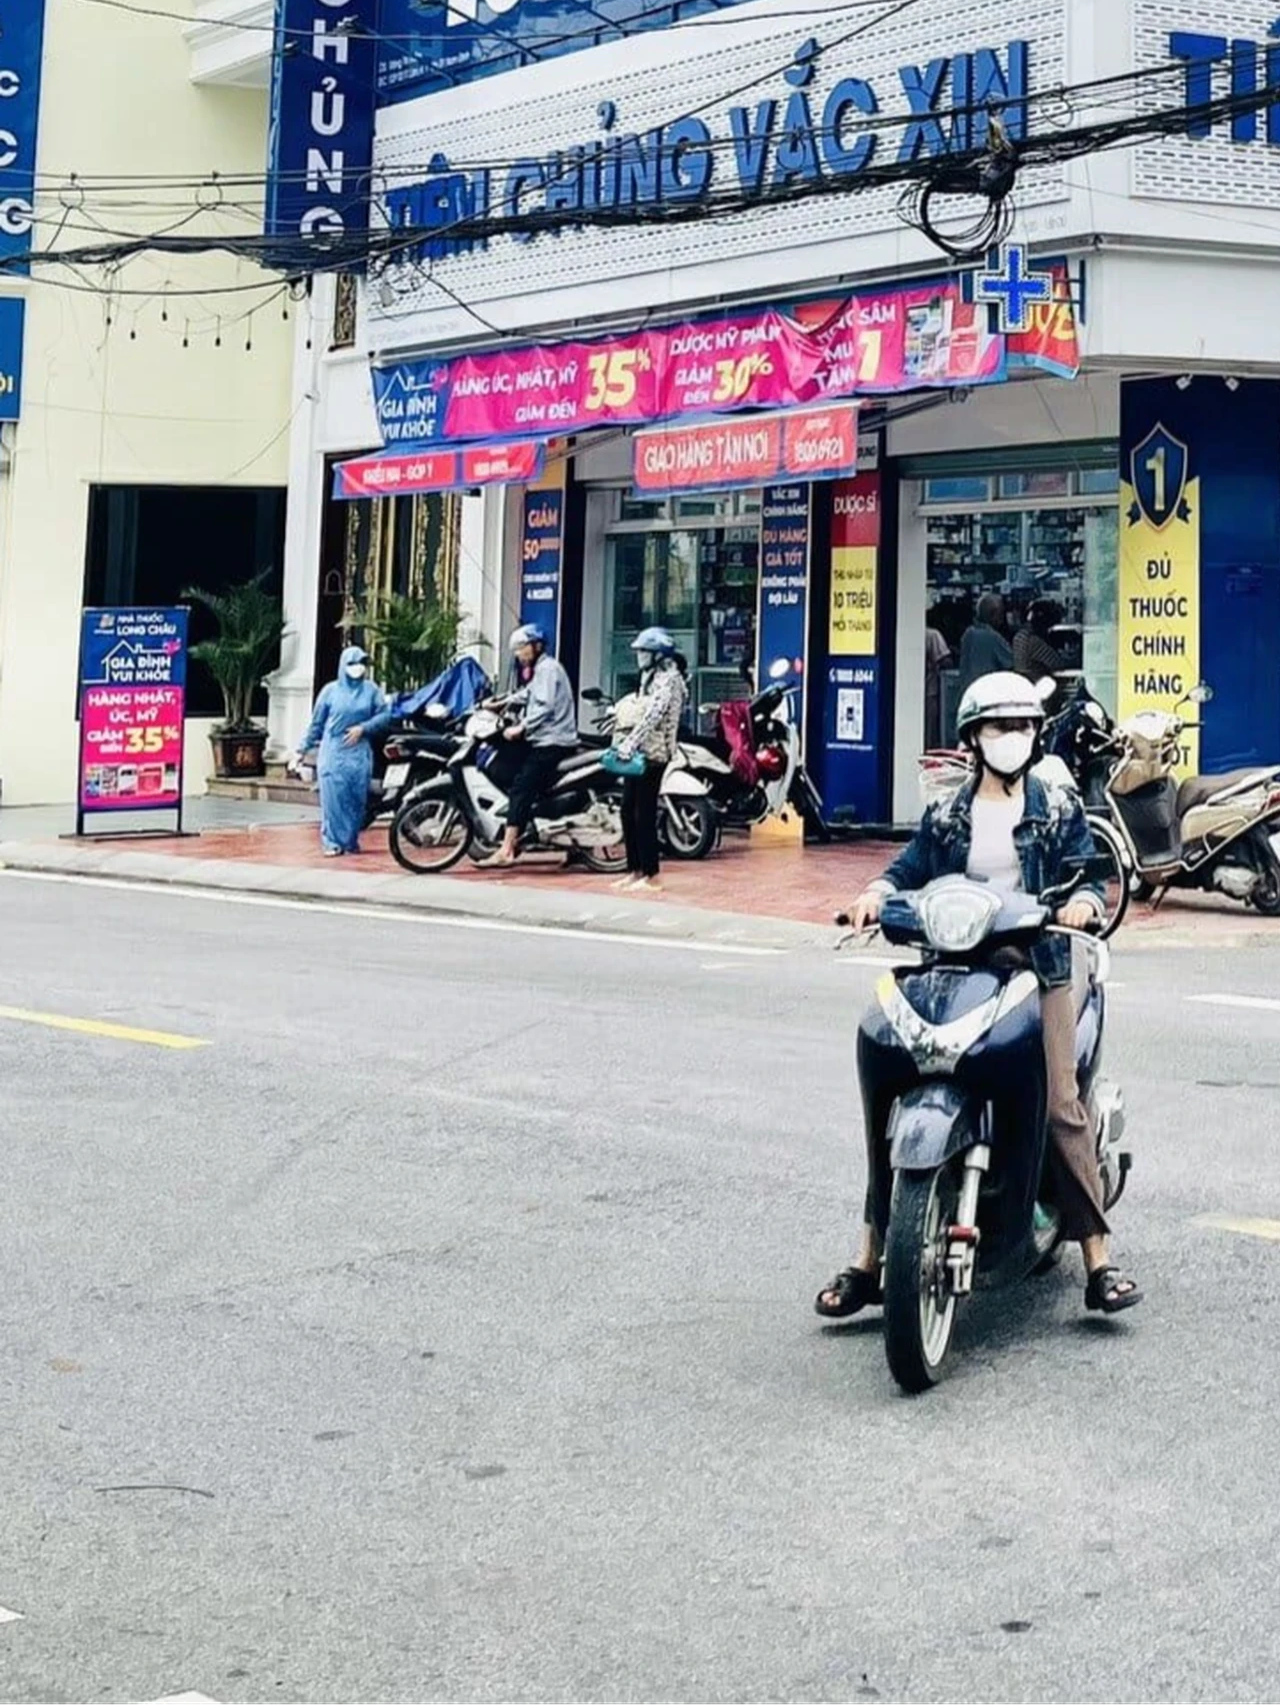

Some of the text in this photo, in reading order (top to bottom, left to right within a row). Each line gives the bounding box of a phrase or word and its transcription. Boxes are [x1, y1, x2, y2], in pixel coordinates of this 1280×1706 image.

[503, 101, 714, 243] CHỦNG
[730, 37, 880, 194] VẮC
[898, 40, 1028, 166] XIN
[858, 302, 896, 326] SÂM
[584, 347, 651, 411] 35%
[712, 352, 774, 402] 30%
[381, 398, 404, 420] GIA
[1145, 447, 1165, 511] 1
[1146, 551, 1172, 580] ĐỦ
[1129, 589, 1188, 618] THUỐC
[117, 622, 176, 636] LONG CHÂU
[1131, 630, 1186, 657] CHÍNH
[110, 657, 135, 670] GIA
[111, 670, 133, 682] VUI
[1133, 667, 1183, 695] HÃNG
[88, 690, 132, 707] HÀNG
[124, 725, 180, 754] 35%
